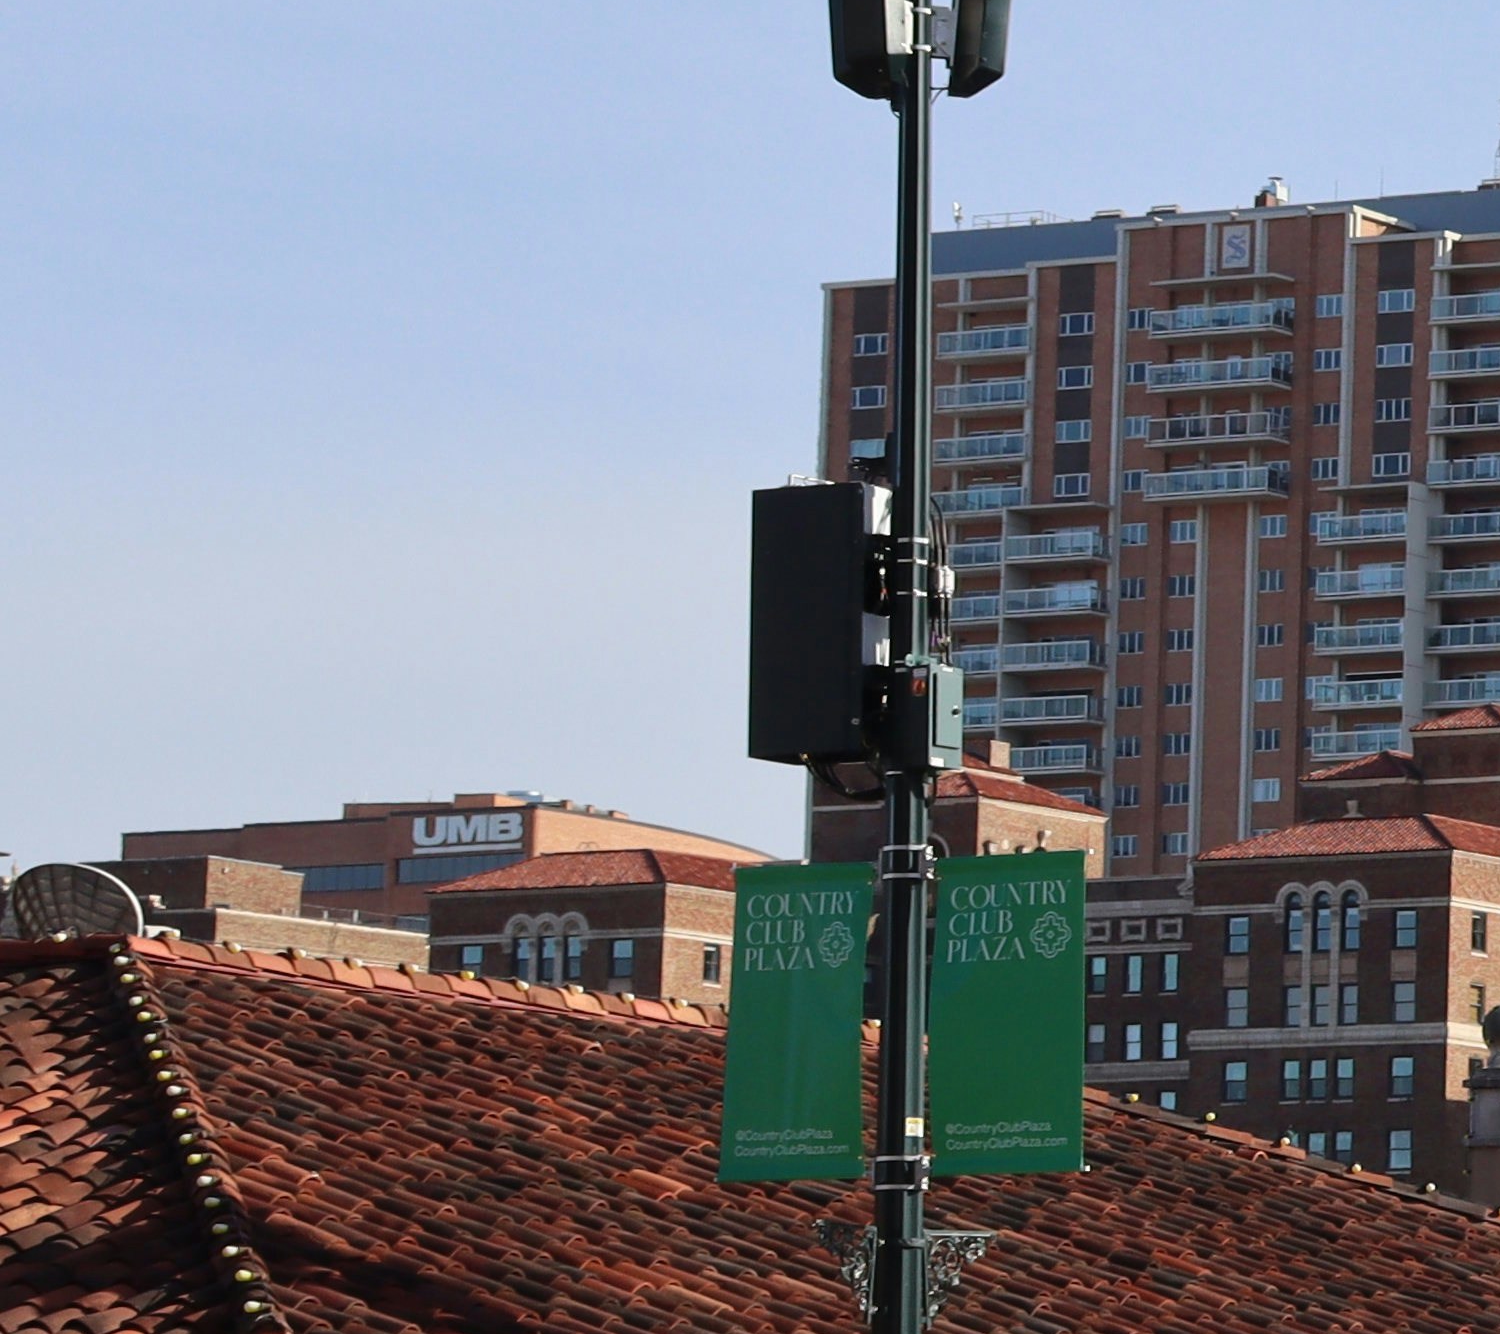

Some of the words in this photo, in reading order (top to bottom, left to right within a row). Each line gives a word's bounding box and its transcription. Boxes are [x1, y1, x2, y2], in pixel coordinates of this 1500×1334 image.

[413, 812, 523, 846] UMB
[747, 891, 859, 919] COUNTRY
[951, 879, 1071, 910] COUNTRY
[746, 920, 805, 945] CLUB
[949, 910, 1013, 936] CLUB
[744, 946, 815, 971] PLAZA
[947, 937, 1025, 963] PLAZA
